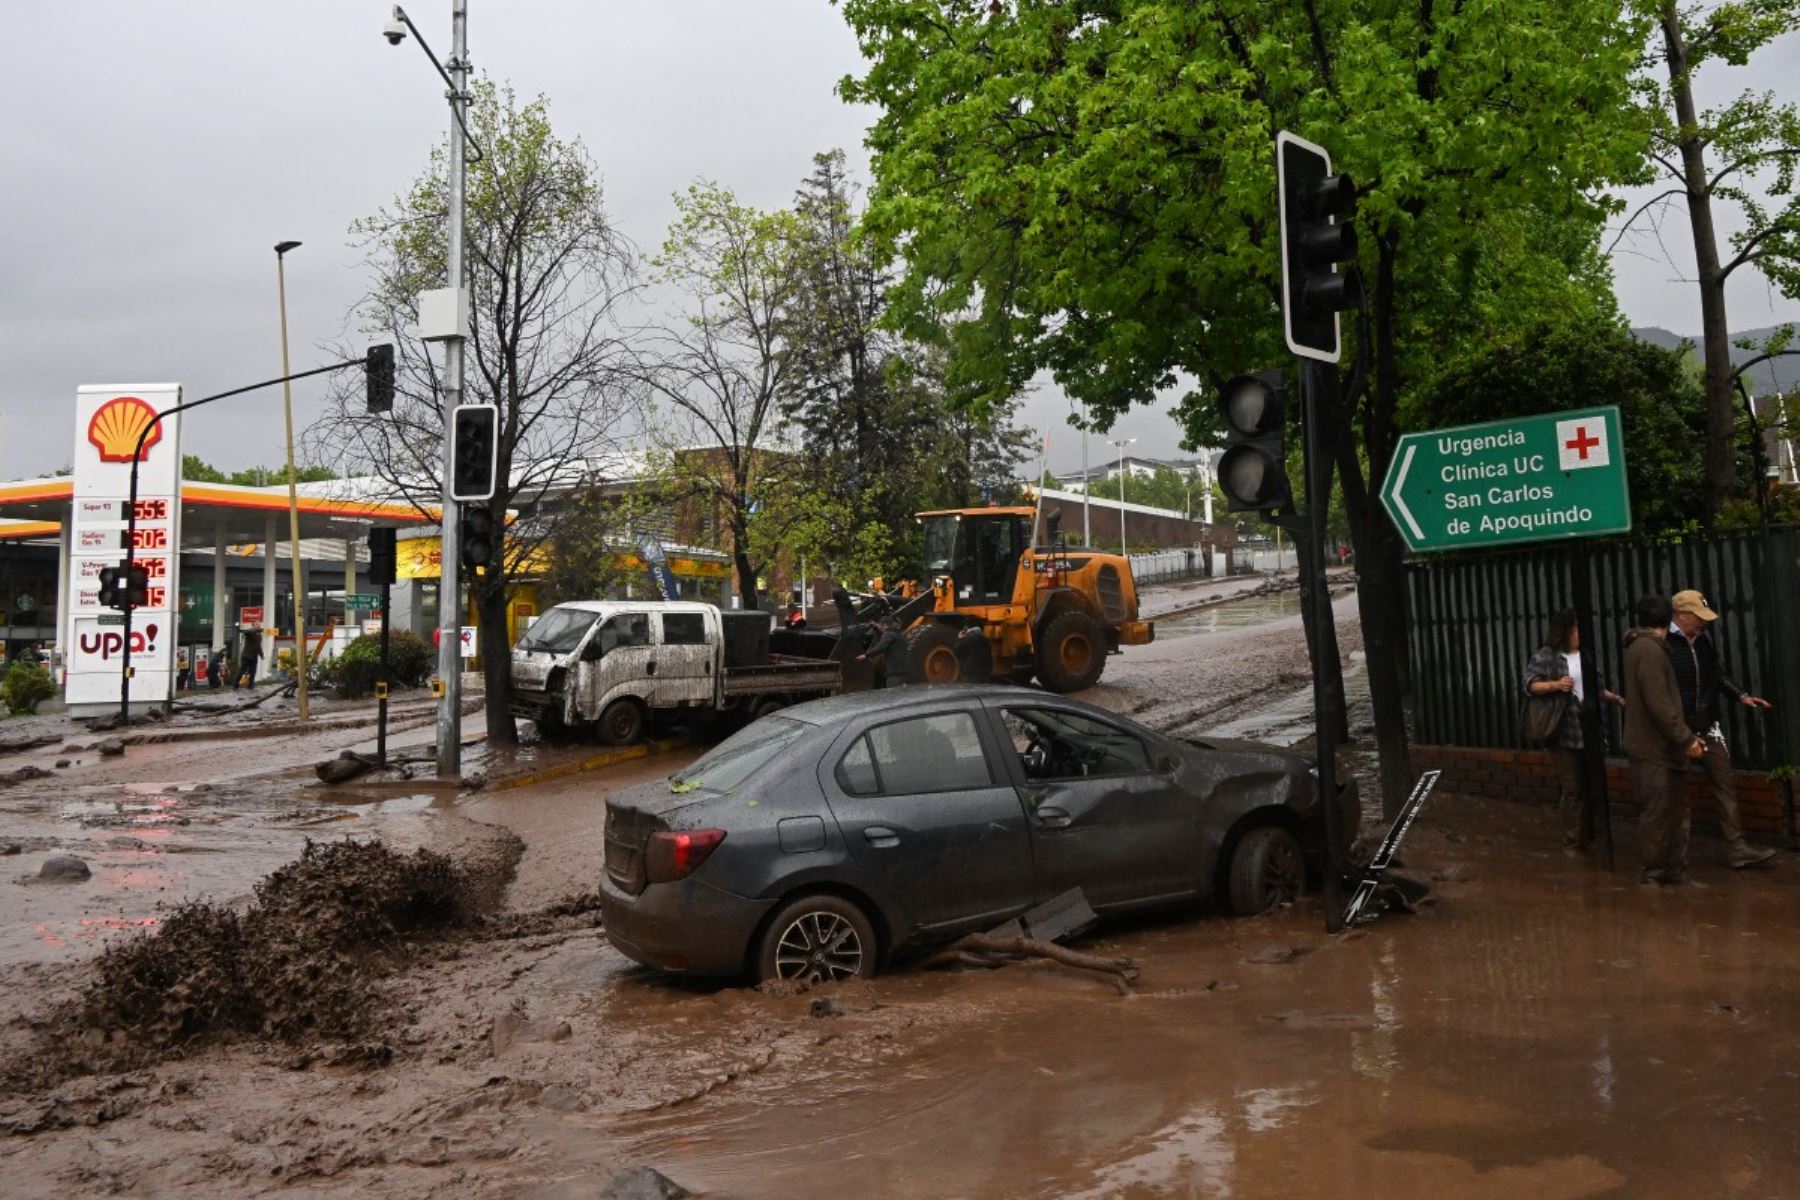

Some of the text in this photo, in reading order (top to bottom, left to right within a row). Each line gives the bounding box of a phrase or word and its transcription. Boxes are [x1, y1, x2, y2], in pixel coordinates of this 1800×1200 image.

[1438, 429, 1525, 457] Urgencia
[1441, 455, 1544, 483] Clínica UC
[1444, 484, 1553, 510] San Carlos
[1447, 505, 1592, 535] de Apoquindo
[81, 623, 158, 660] upa!
